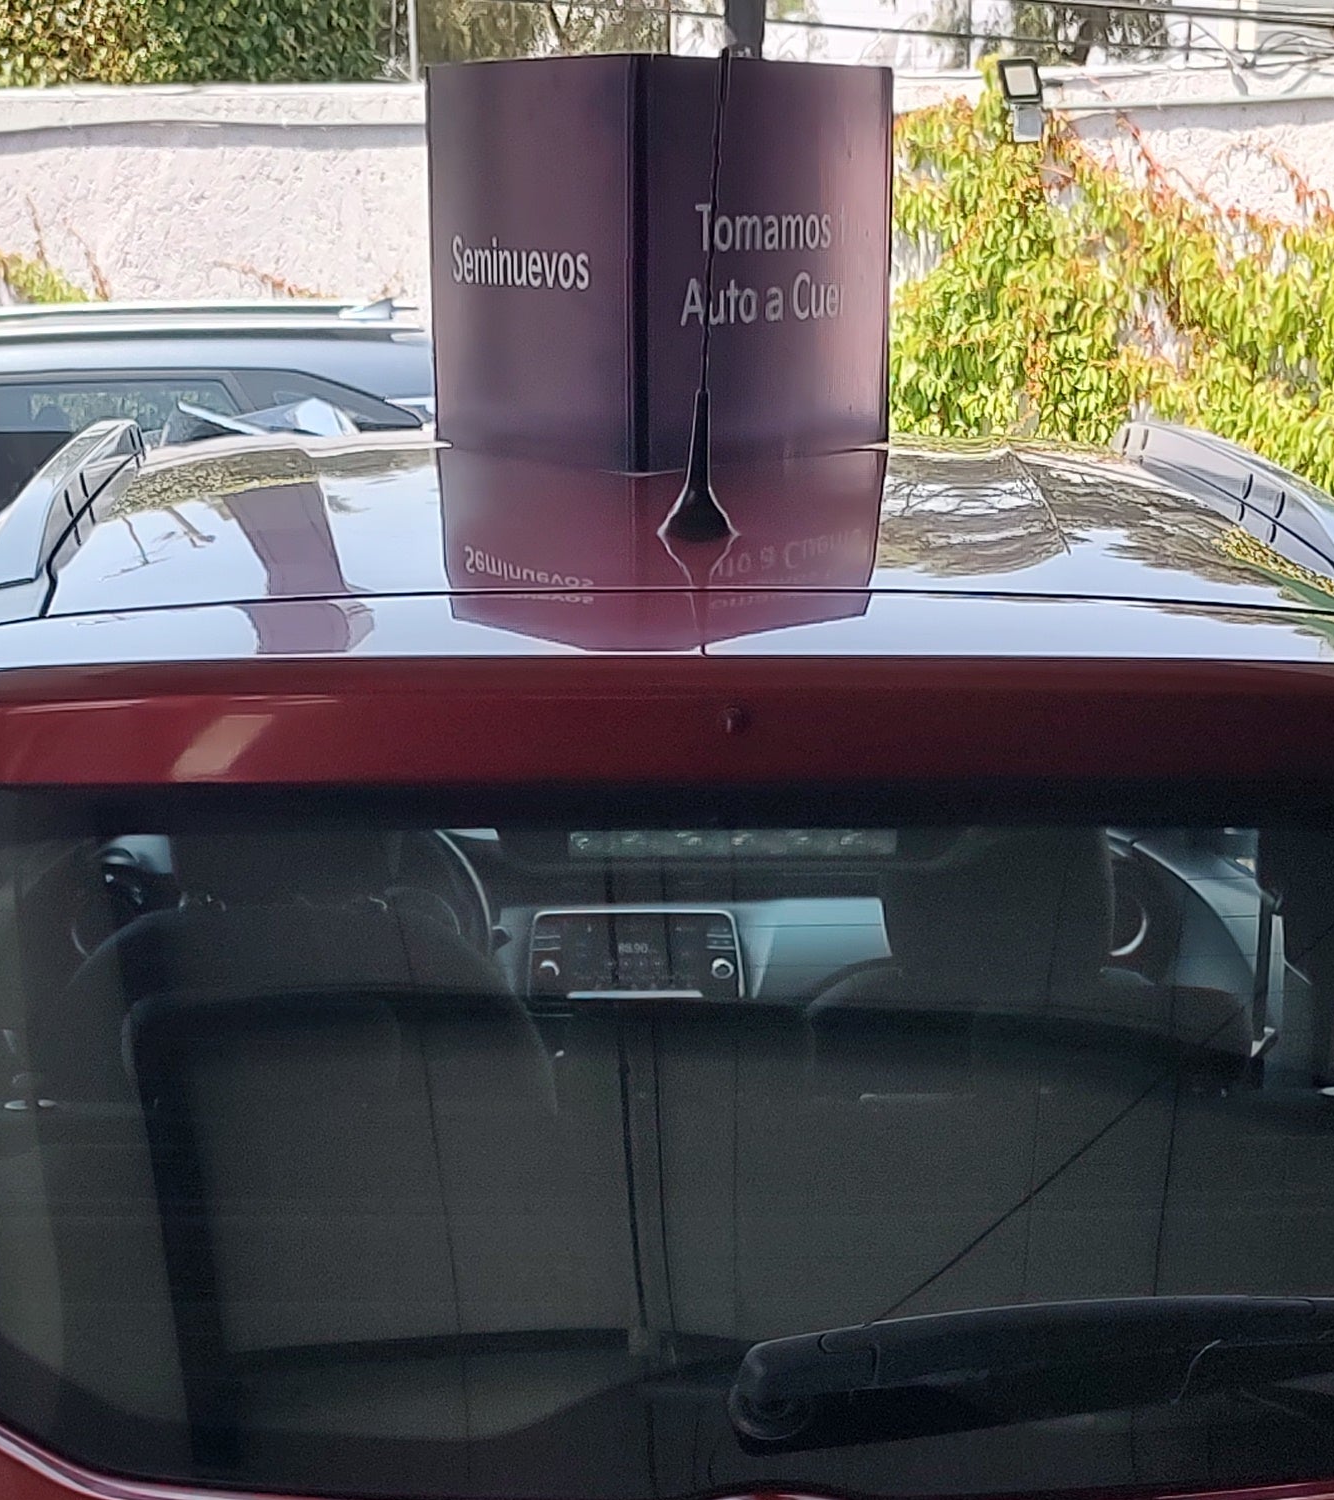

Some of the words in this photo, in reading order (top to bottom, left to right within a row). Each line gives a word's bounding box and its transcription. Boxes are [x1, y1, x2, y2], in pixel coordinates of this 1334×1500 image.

[695, 203, 831, 252] Tomamos
[452, 235, 589, 290] Seminuevos
[681, 278, 758, 326] Auto
[765, 286, 783, 322] a
